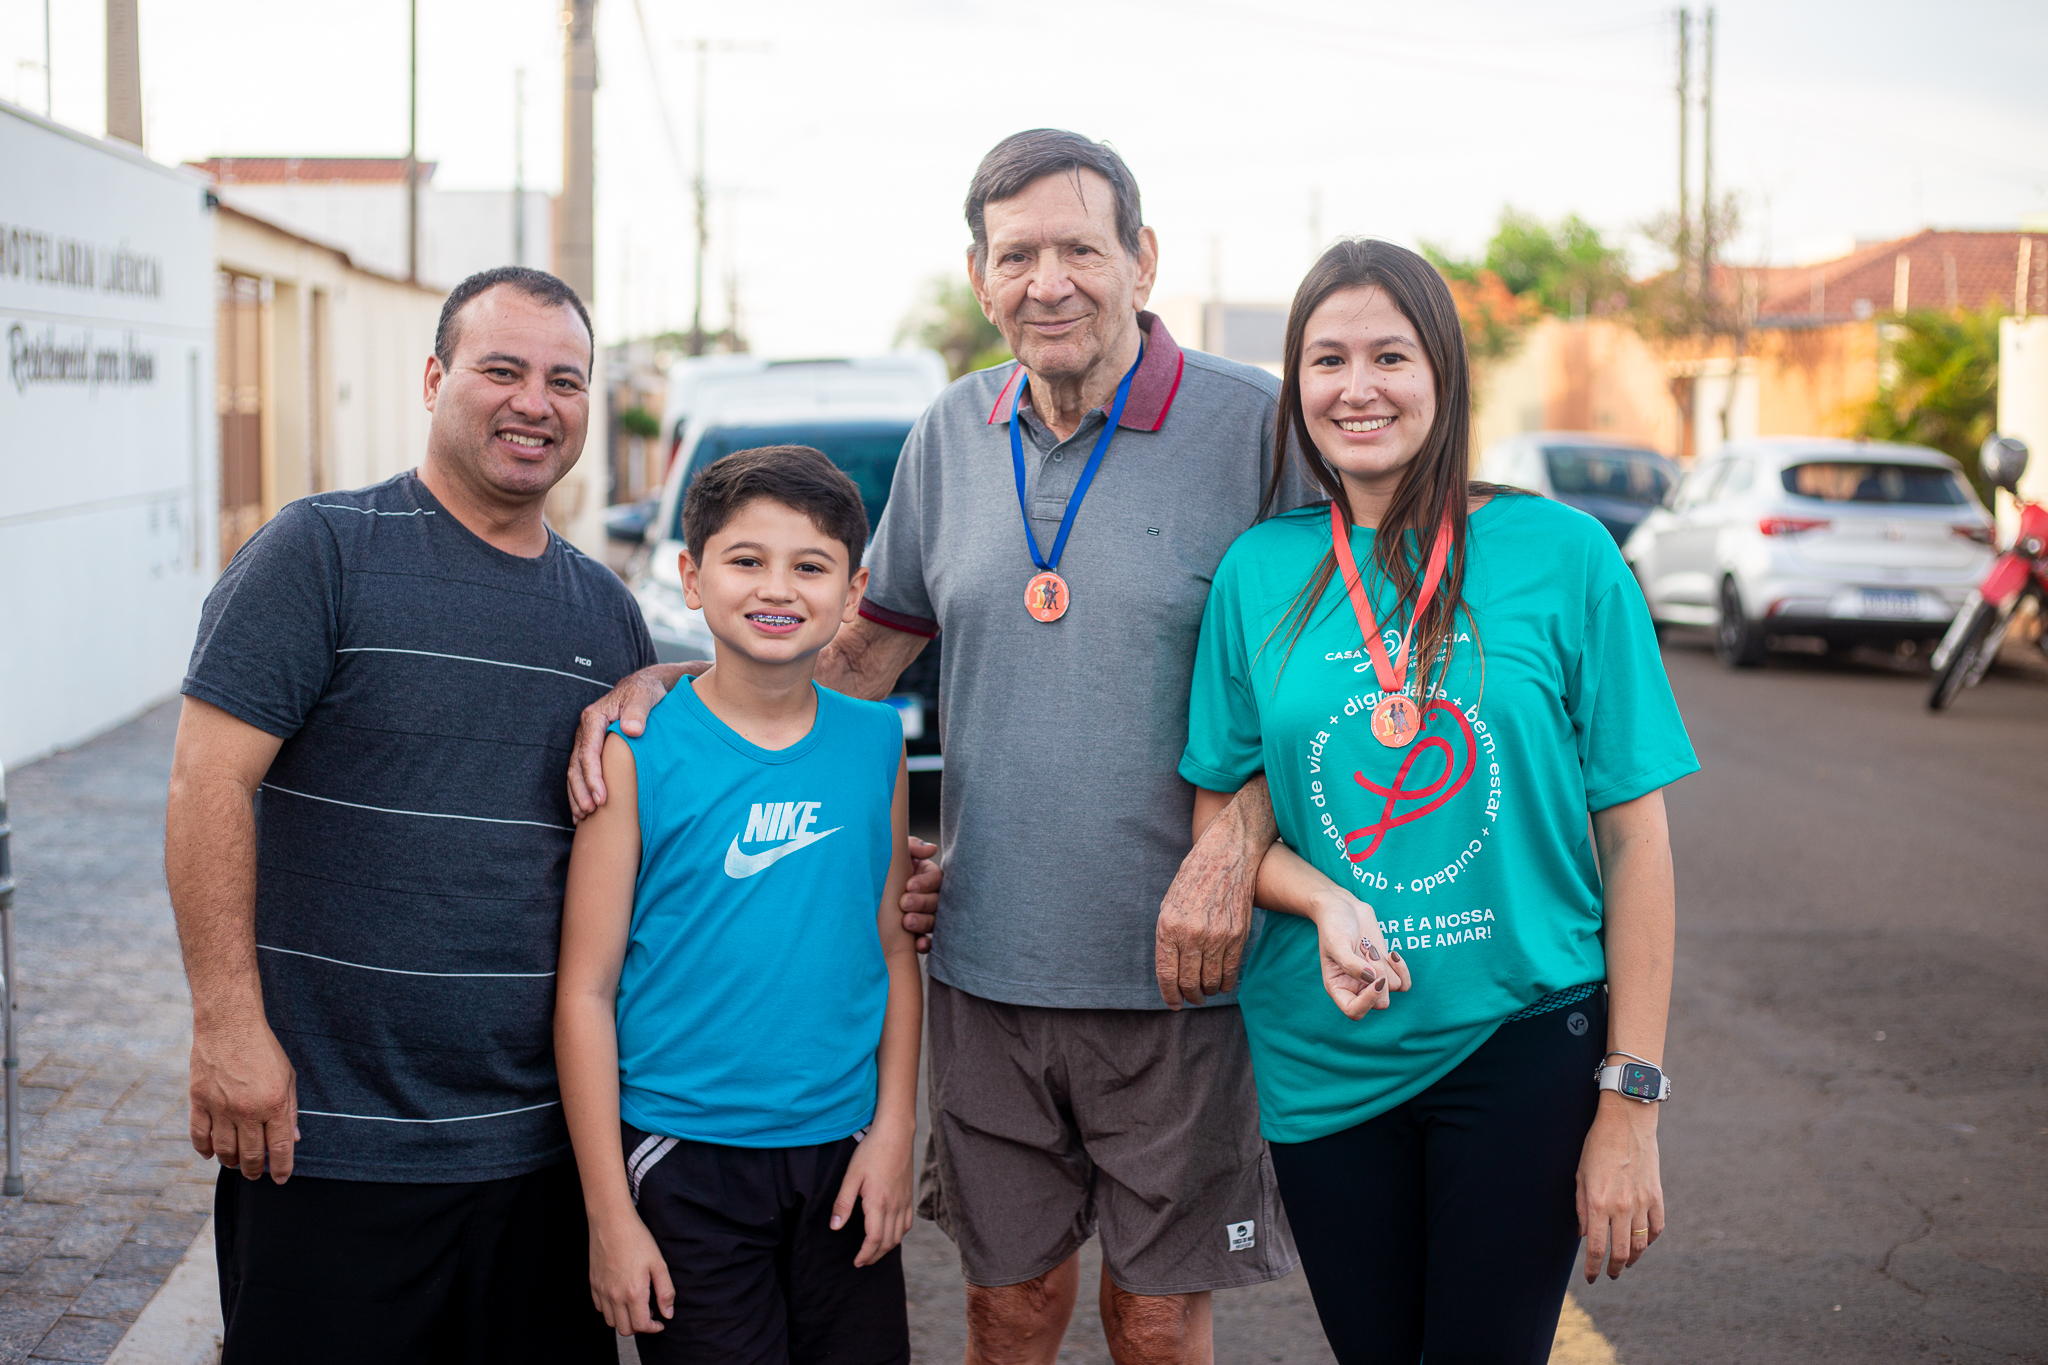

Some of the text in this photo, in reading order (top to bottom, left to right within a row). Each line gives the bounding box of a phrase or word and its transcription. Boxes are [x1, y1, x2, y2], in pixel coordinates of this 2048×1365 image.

[575, 656, 592, 667] FICO
[1325, 650, 1362, 661] CASA
[1307, 730, 1330, 774] vida
[1463, 703, 1502, 823] bem-estar
[1310, 780, 1326, 808] de
[743, 801, 822, 843] NIKE
[1321, 812, 1388, 890] quadade
[1410, 839, 1482, 895] cuidado
[1403, 915, 1415, 931] É
[1418, 916, 1432, 930] A
[1435, 908, 1495, 929] NOSSA
[1406, 935, 1432, 949] DE
[1435, 925, 1492, 947] AMAR!
